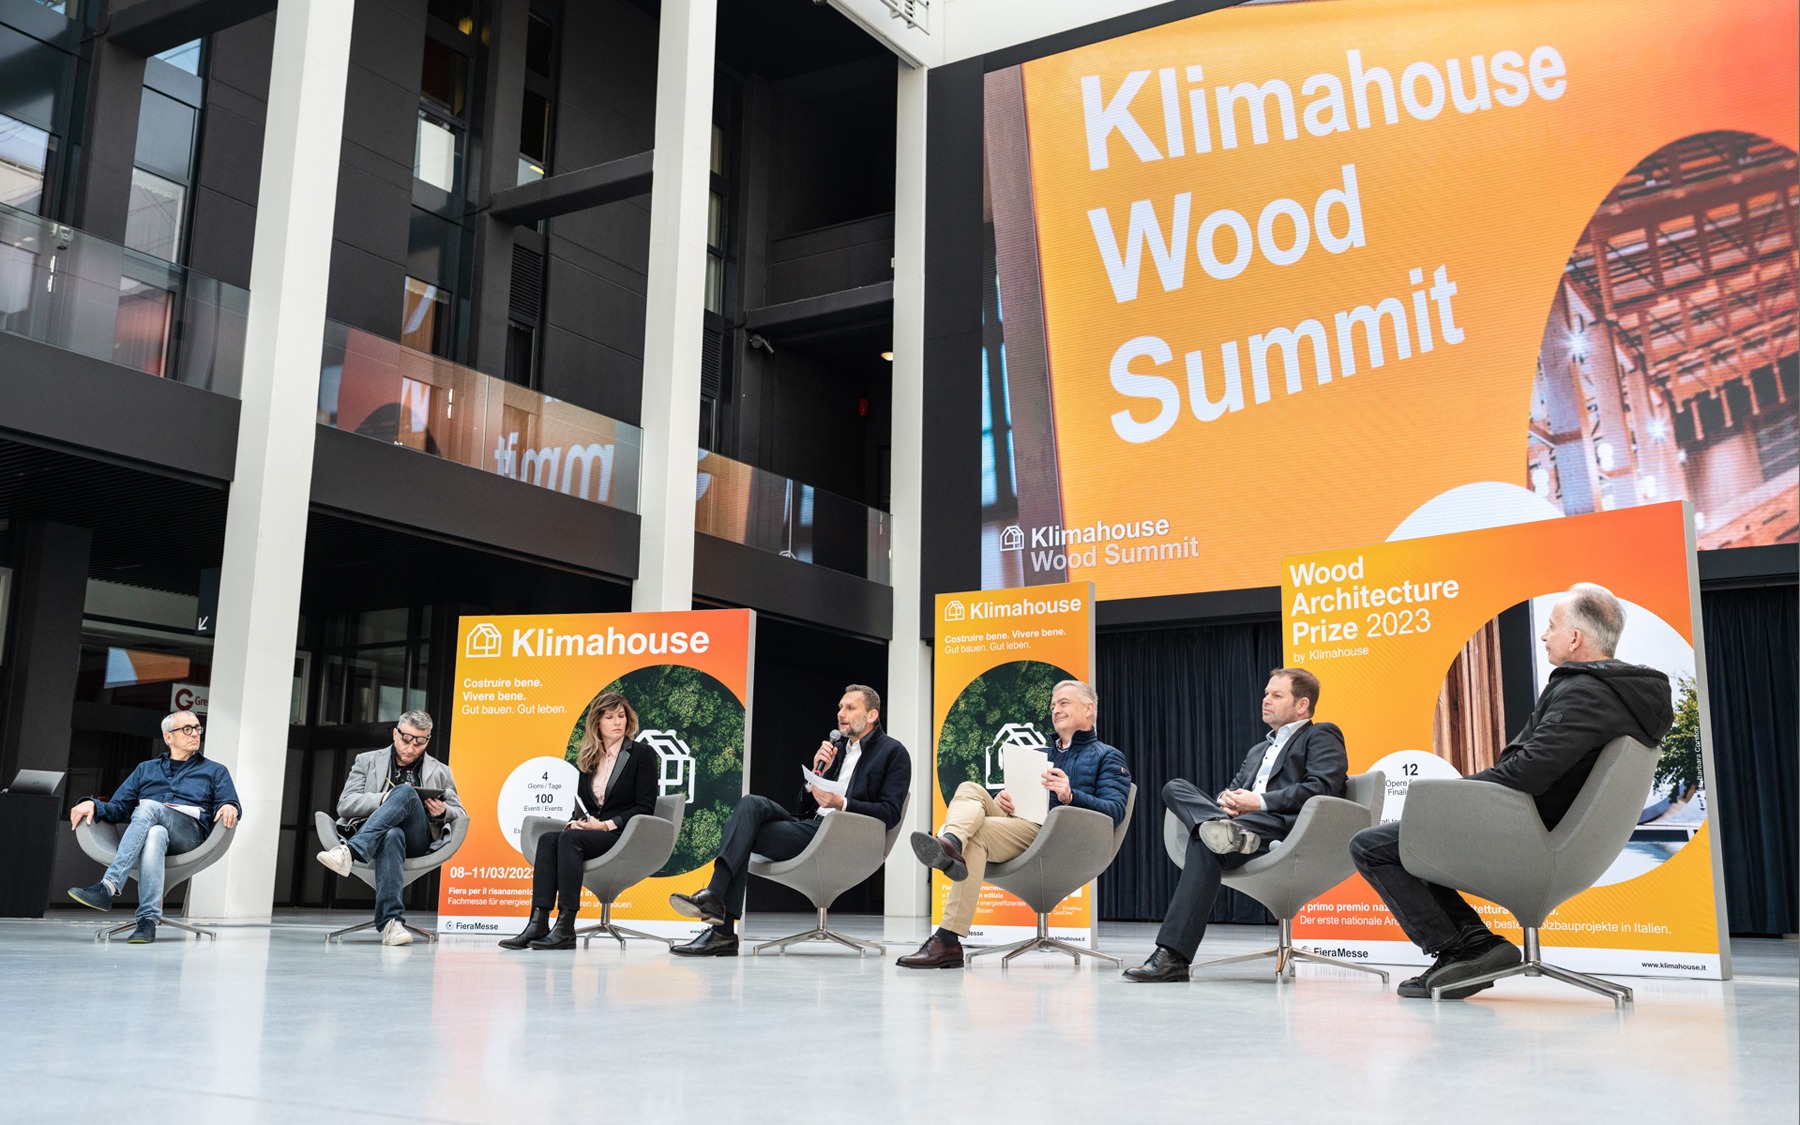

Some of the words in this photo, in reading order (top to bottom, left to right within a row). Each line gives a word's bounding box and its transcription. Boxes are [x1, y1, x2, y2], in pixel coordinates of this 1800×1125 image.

[1080, 44, 1567, 171] Klimahouse
[1087, 163, 1367, 304] Wood
[1107, 264, 1466, 445] Summit
[1031, 518, 1170, 549] Klimahouse
[1031, 546, 1097, 573] Wood
[1104, 535, 1200, 566] Summit
[1289, 555, 1365, 588] Wood
[1290, 578, 1460, 617] Architecture
[970, 597, 1082, 620] Klimahouse
[1292, 619, 1359, 647] Prize
[1366, 607, 1431, 638] 2023
[511, 626, 710, 657] Klimahouse
[944, 633, 984, 644] Costruire
[986, 630, 1010, 641] bene.
[1012, 629, 1040, 639] Vivere
[1041, 627, 1067, 637] bene.
[944, 645, 959, 655] Gut
[960, 642, 988, 653] bauen.
[989, 641, 1005, 651] Gut
[1006, 640, 1032, 650] leben.
[1293, 651, 1306, 664] by
[1309, 646, 1370, 661] Klimahouse
[463, 678, 512, 689] Costruire
[514, 677, 543, 688] bene.
[194, 696, 209, 707] Gre
[463, 691, 495, 701] Vivere
[497, 691, 526, 701] bene.
[462, 704, 479, 715] Gut
[481, 704, 515, 714] bauen.
[517, 703, 536, 714] Gut
[537, 703, 567, 714] leben.
[541, 771, 549, 781] 4
[1401, 763, 1418, 776] 12
[1385, 779, 1408, 789] Opere
[535, 794, 554, 804] 100
[448, 887, 467, 895] Fiera
[468, 888, 481, 896] per
[482, 887, 488, 895] il
[448, 897, 488, 905] Fachmesse
[1307, 902, 1335, 912] primo
[1337, 903, 1371, 912] premio
[456, 921, 499, 931] FieraMesse
[1300, 915, 1315, 924] Der
[1317, 916, 1339, 925] erste
[1341, 916, 1382, 925] nationale
[1540, 920, 1619, 934] olzbauprojekte
[1621, 923, 1632, 933] in
[1634, 923, 1673, 935] Italien.
[1313, 948, 1369, 958] FieraMesse
[1640, 961, 1707, 972] www.klimahouse.it
